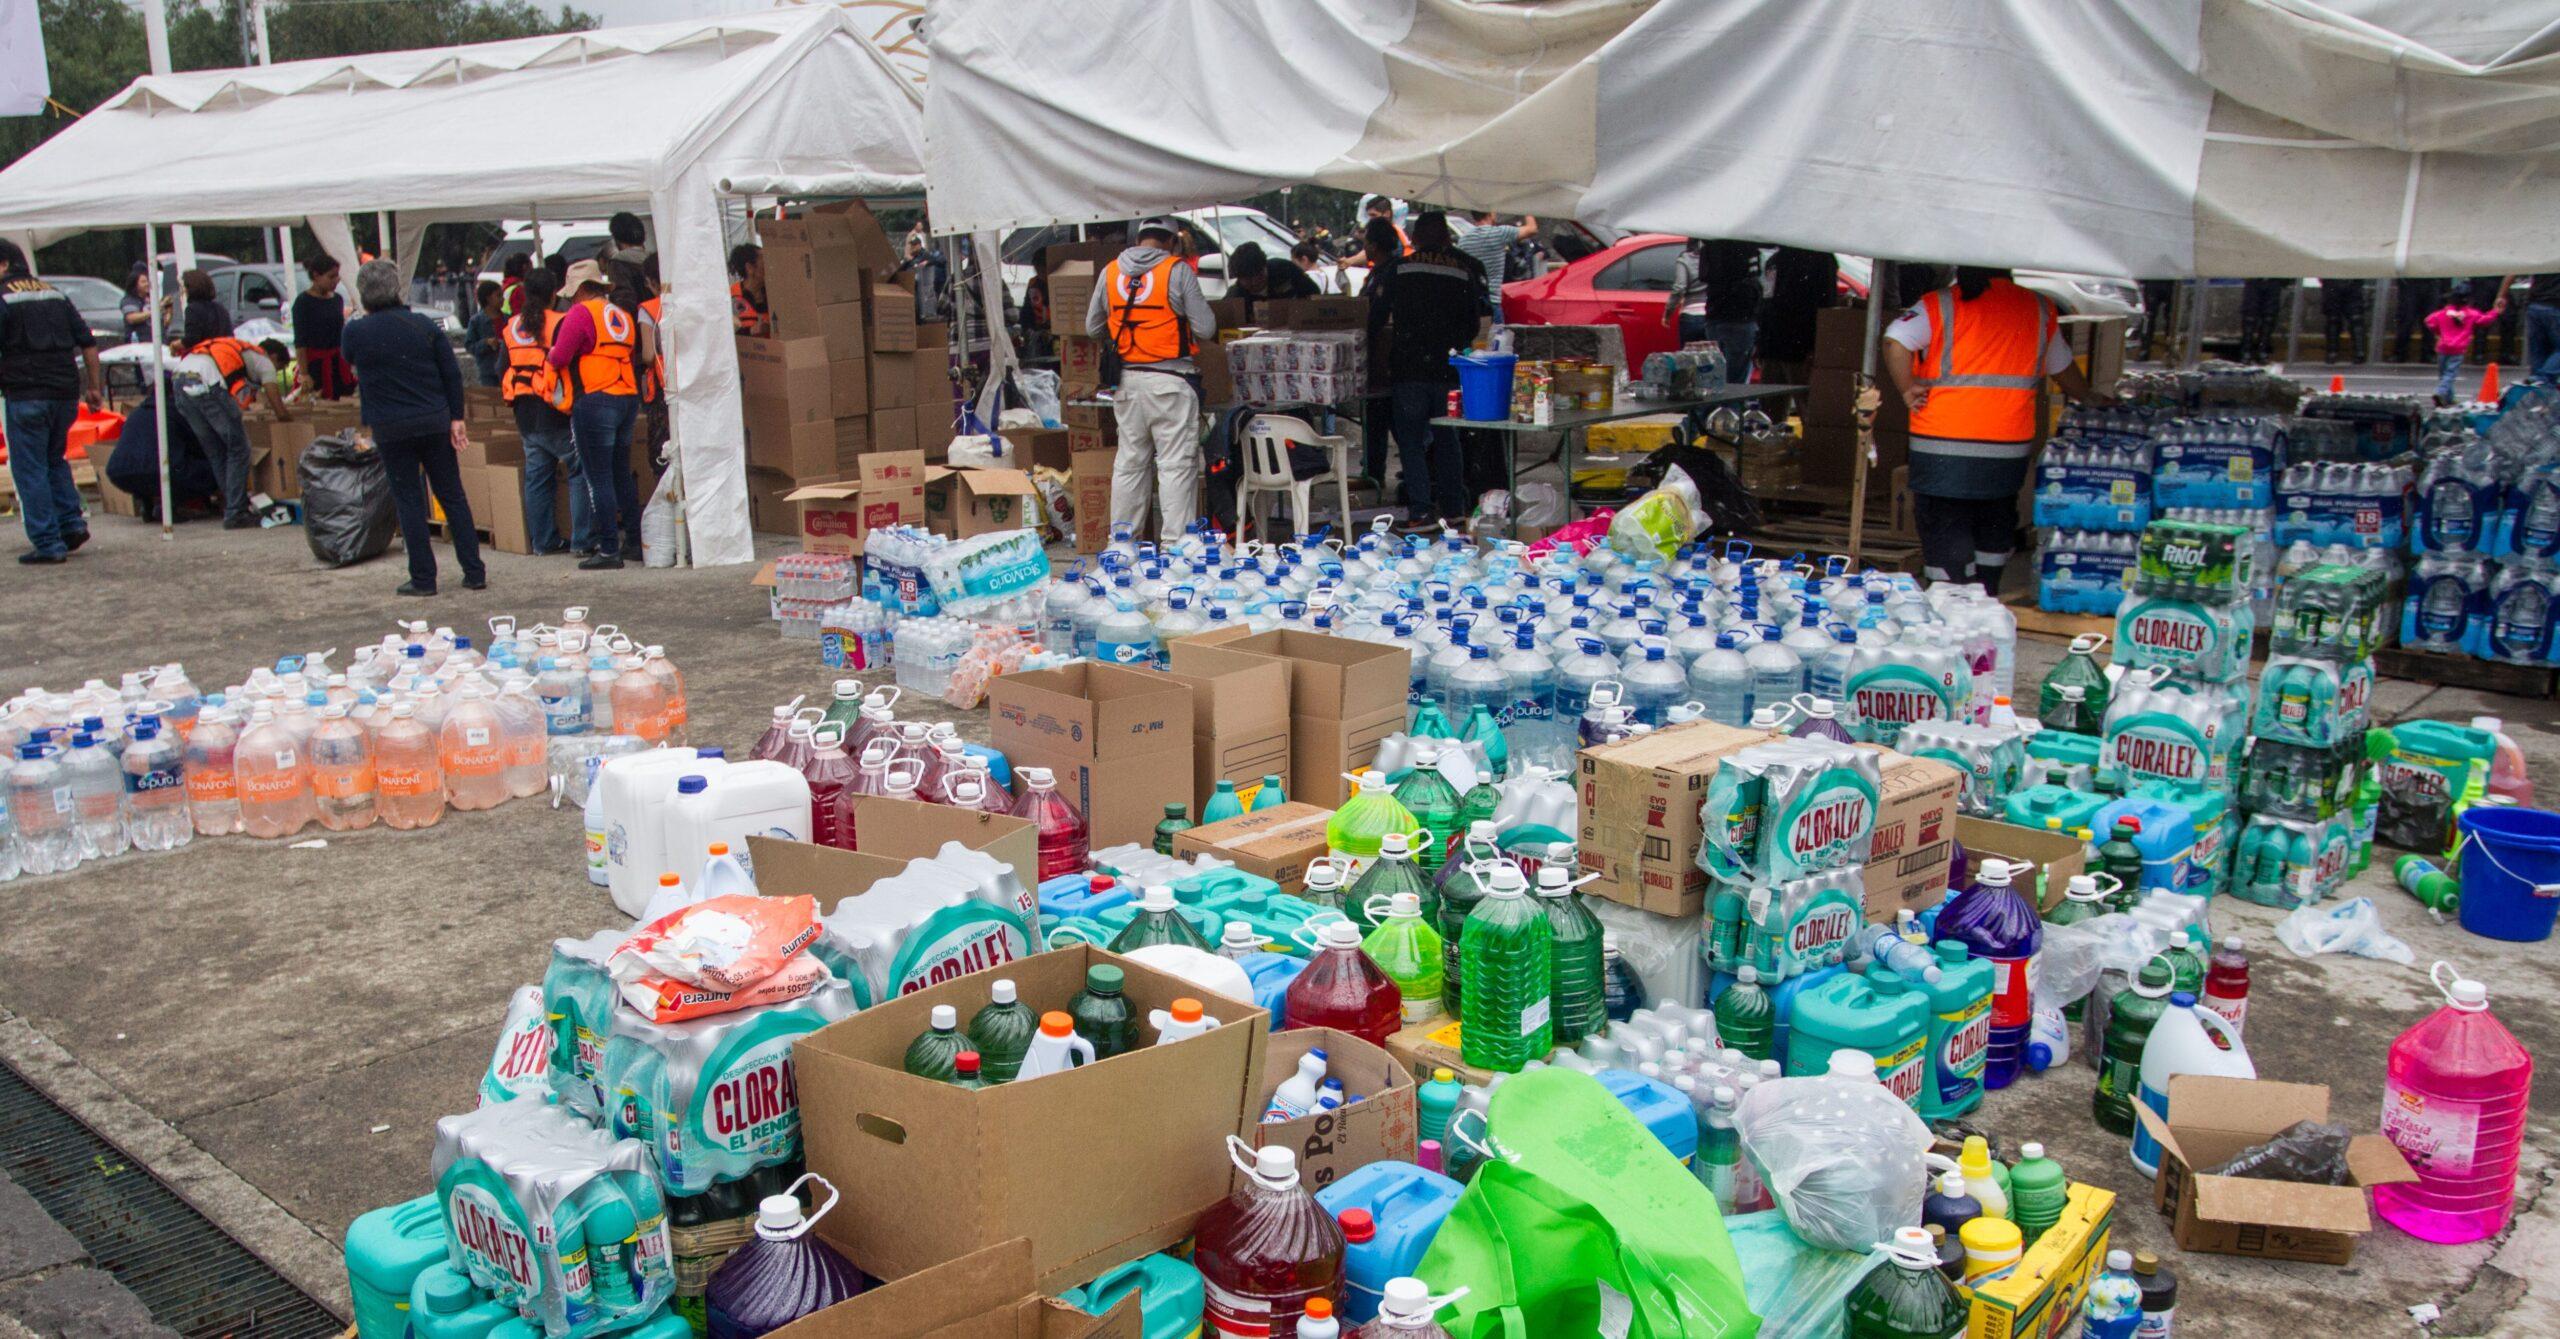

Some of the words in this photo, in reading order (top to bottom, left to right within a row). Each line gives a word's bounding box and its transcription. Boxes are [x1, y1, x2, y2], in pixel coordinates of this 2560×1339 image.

[2356, 512, 2377, 524] 18
[900, 581, 915, 593] 18
[2134, 617, 2207, 652] CLORALEX
[1116, 647, 1133, 658] ciel
[1943, 672, 1953, 686] 8
[1856, 690, 1938, 723] CLORALEX
[2205, 724, 2215, 739] 8
[2116, 733, 2198, 778] CLORALEX
[1975, 764, 1989, 775] 20
[1649, 795, 1667, 806] EVO
[1794, 797, 1865, 853] CLORALEX
[1871, 823, 1906, 855] ORALEX
[1274, 866, 1286, 880] 40
[1643, 870, 1673, 890] CLORALEX
[1017, 892, 1033, 911] 15
[1794, 911, 1851, 951] CLORALEX
[780, 924, 816, 959] Aurrera
[908, 945, 959, 979] DESINFECCIÓN
[964, 921, 999, 945] BLANCURA
[683, 991, 732, 1005] Aurrera
[722, 1051, 779, 1081] DESINFECCIÓN
[1415, 1062, 1428, 1079] NO
[1880, 1058, 1926, 1101] LORALE
[713, 1058, 800, 1135] CLORA
[729, 1133, 748, 1151] EL
[457, 1196, 532, 1287] CLORALEX
